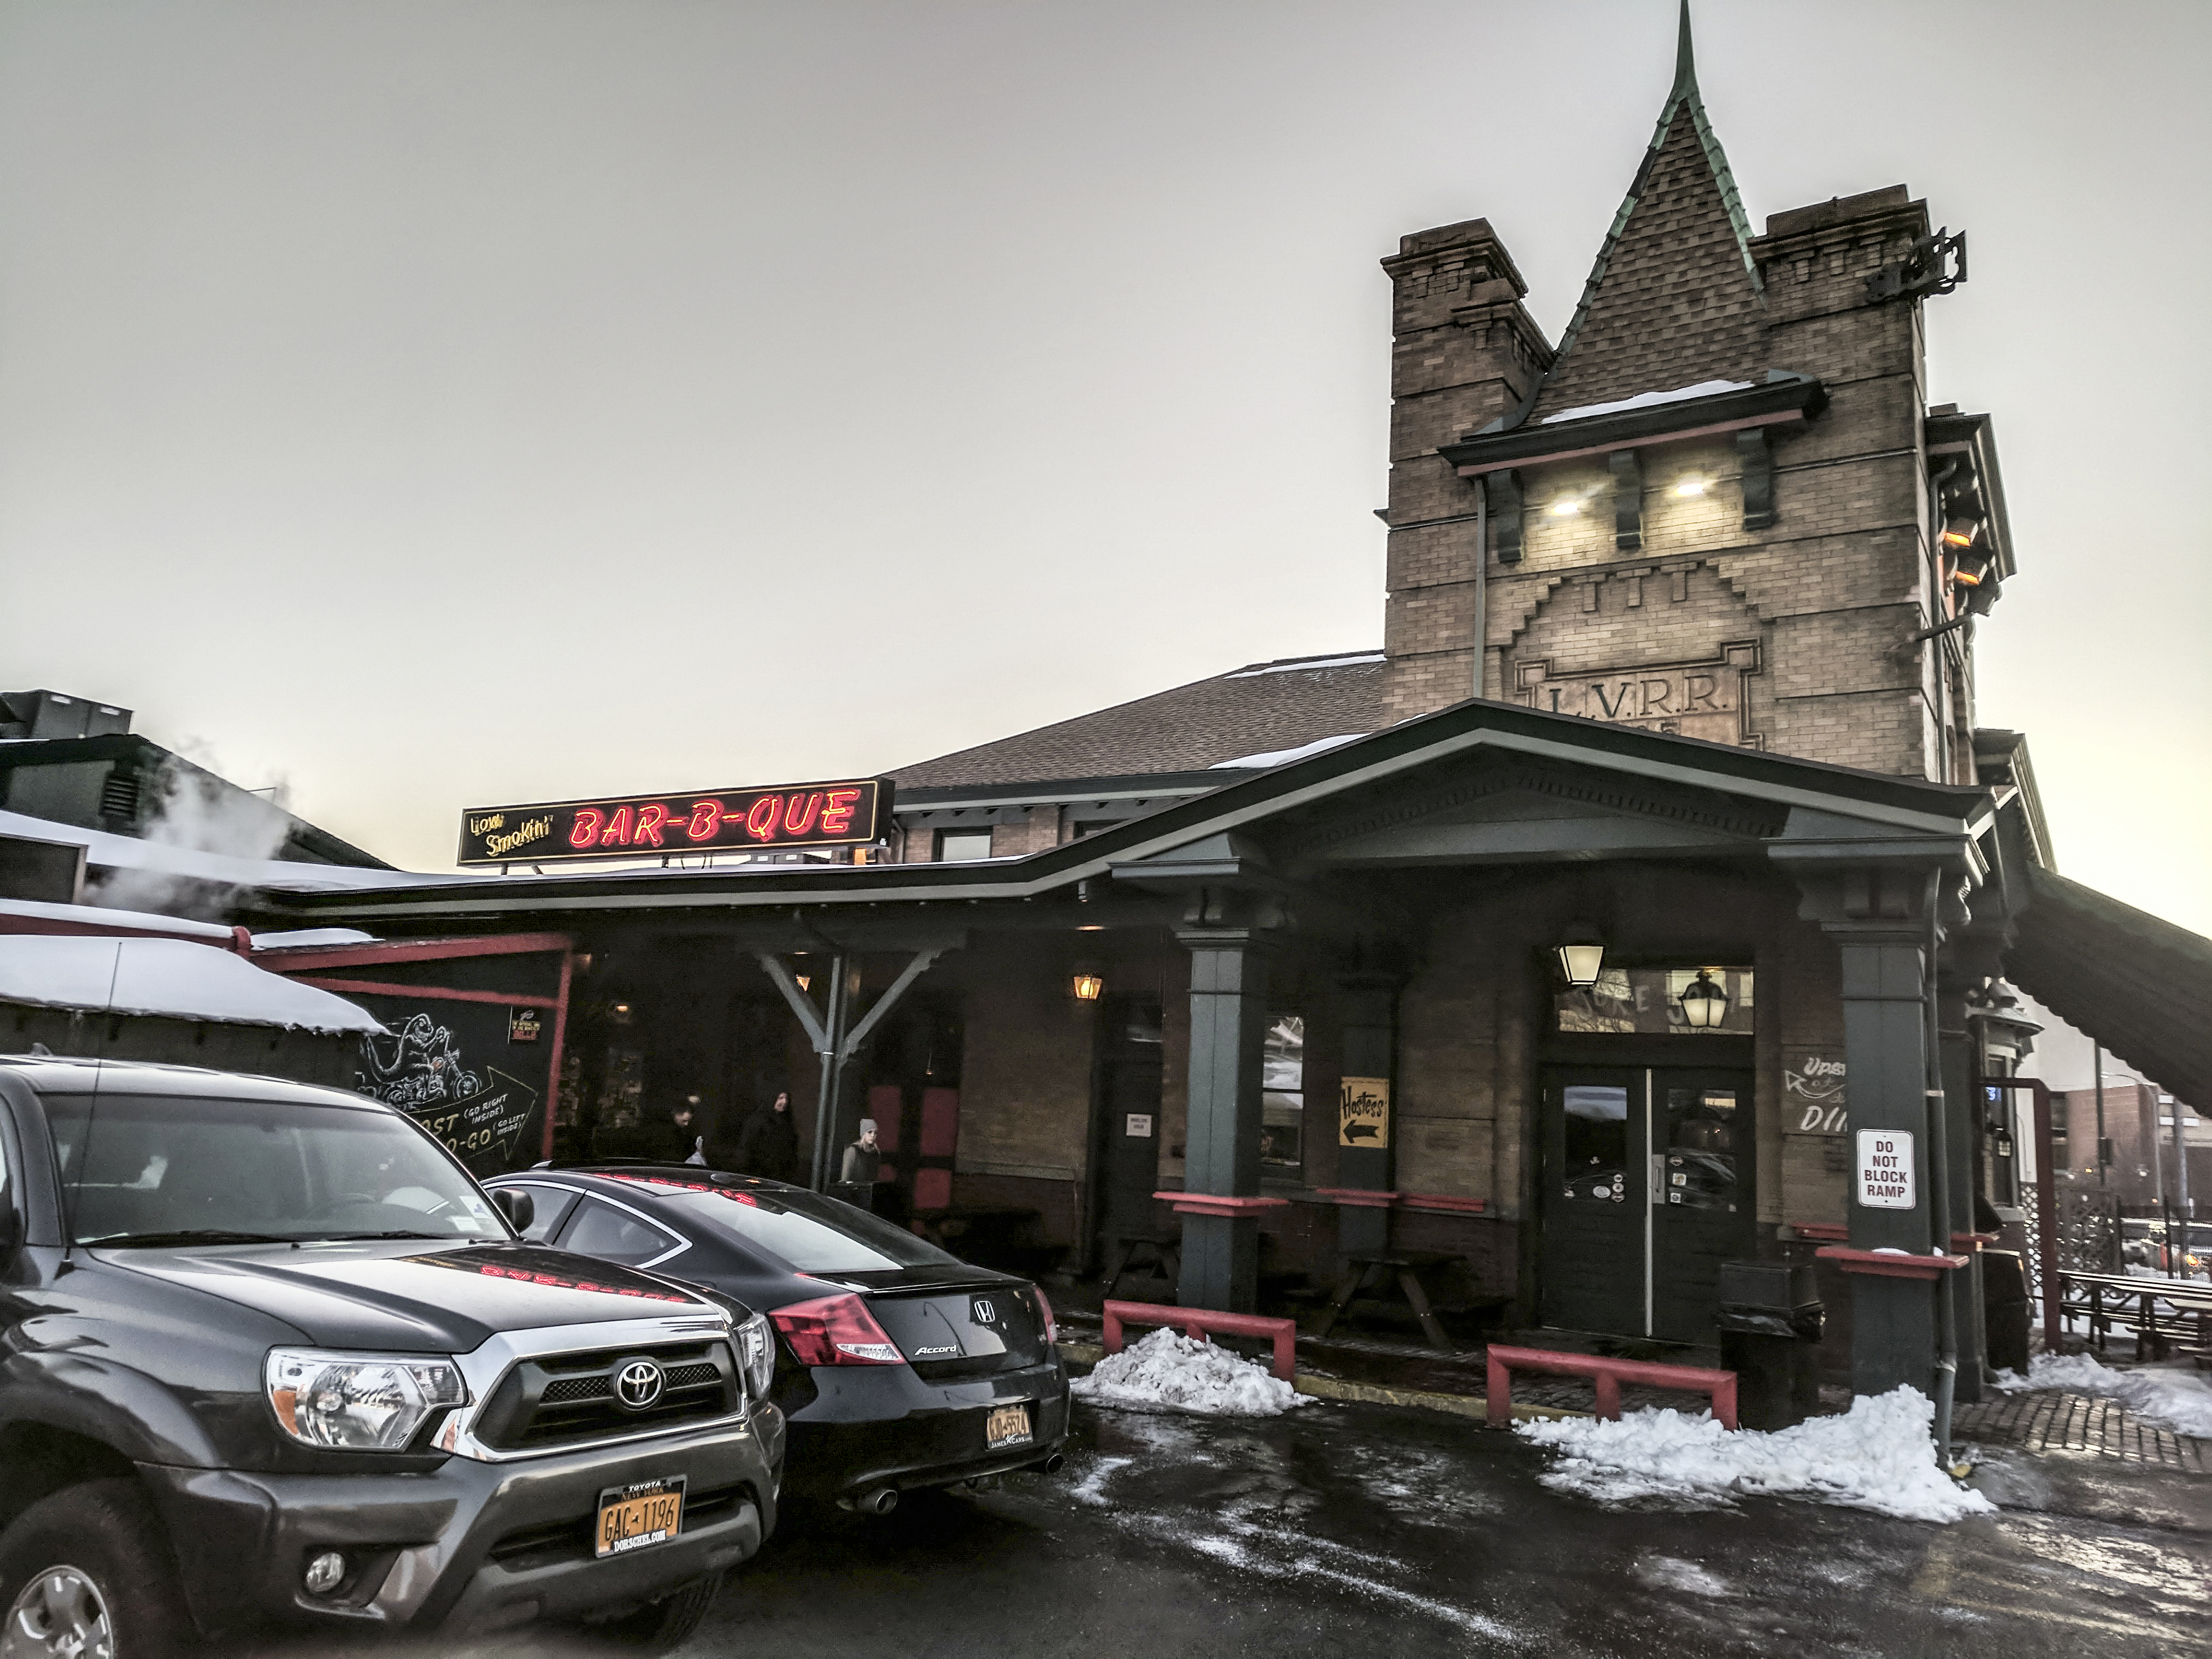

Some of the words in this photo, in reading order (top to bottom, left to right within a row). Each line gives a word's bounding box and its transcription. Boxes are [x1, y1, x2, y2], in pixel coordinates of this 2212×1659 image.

[470, 813, 504, 837] Low
[569, 789, 862, 849] BAR-B-QUE
[482, 1093, 508, 1111] RIGHT
[1342, 1086, 1384, 1119] Hostess
[1876, 1141, 1893, 1152] DO
[1873, 1155, 1898, 1168] NOT
[1864, 1169, 1908, 1184] BLOCK
[1867, 1185, 1905, 1198] RAMP
[914, 1344, 957, 1356] Accord
[628, 1480, 661, 1492] TOYOTA
[614, 1529, 666, 1552] DORSCHEL.COM
